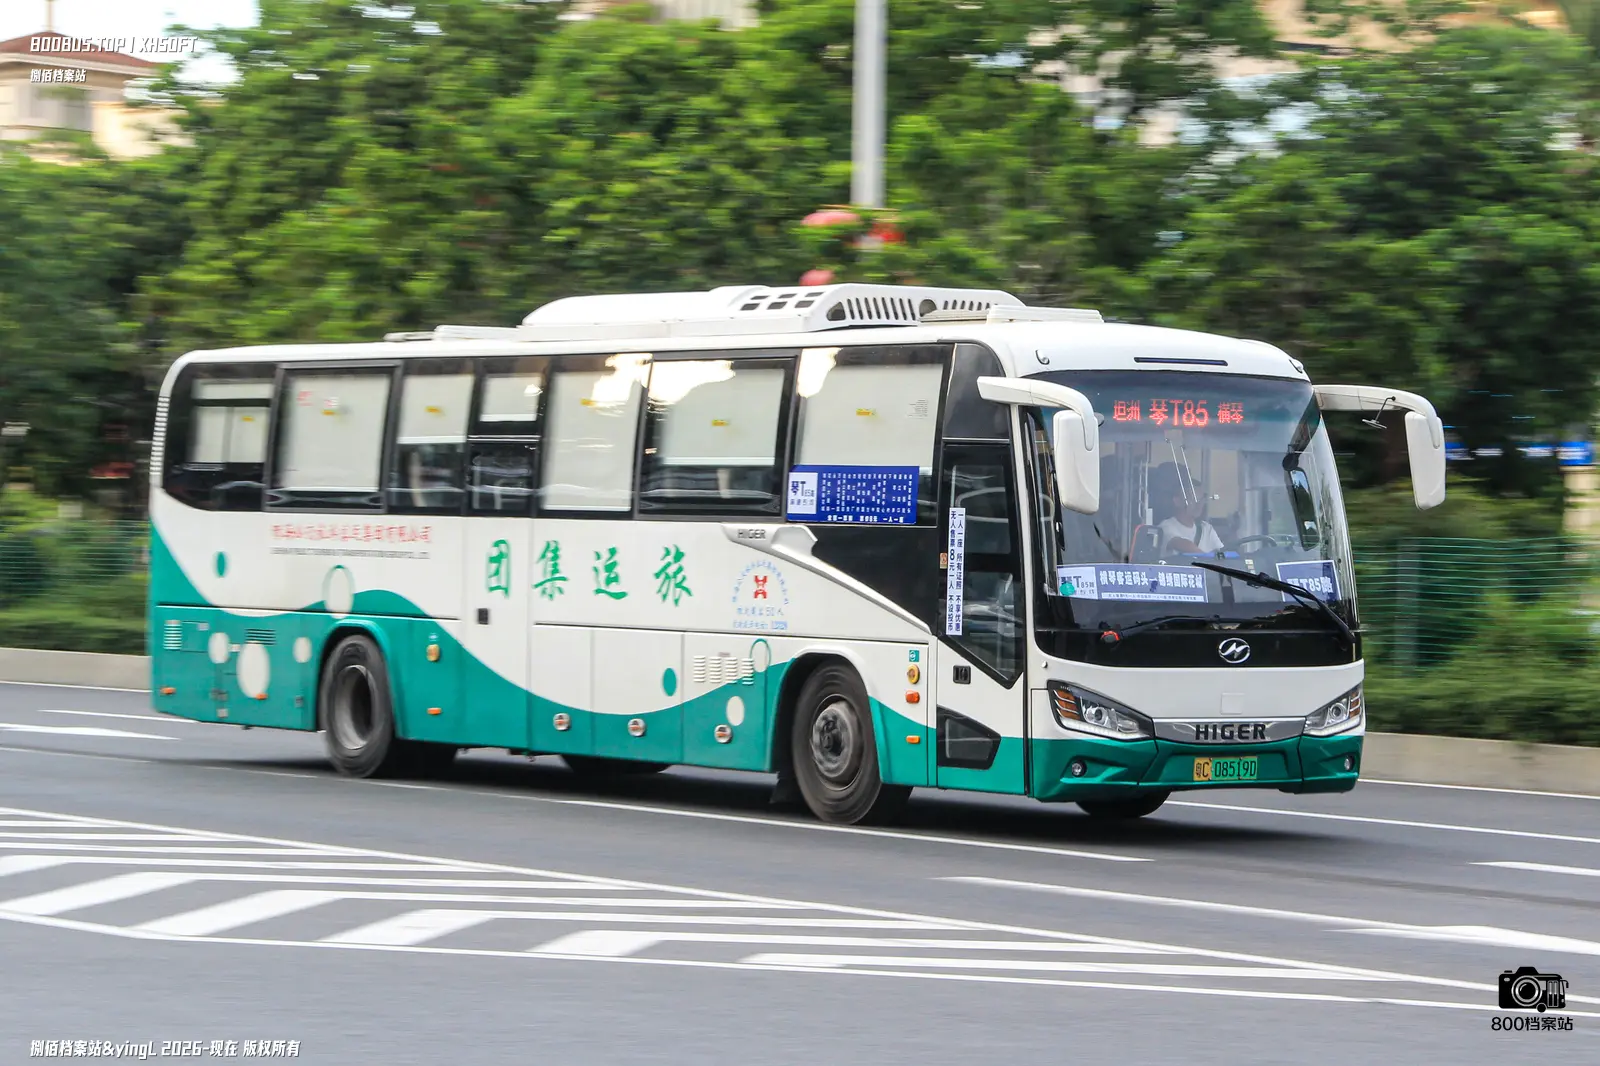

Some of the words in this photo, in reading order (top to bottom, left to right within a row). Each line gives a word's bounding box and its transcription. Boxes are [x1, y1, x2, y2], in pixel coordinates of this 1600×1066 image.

[1113, 400, 1141, 422] 坦洲
[1149, 398, 1209, 427] 琴T85
[1217, 402, 1245, 424] 横琴
[737, 529, 766, 539] HIGER
[1195, 723, 1266, 740] HIGER
